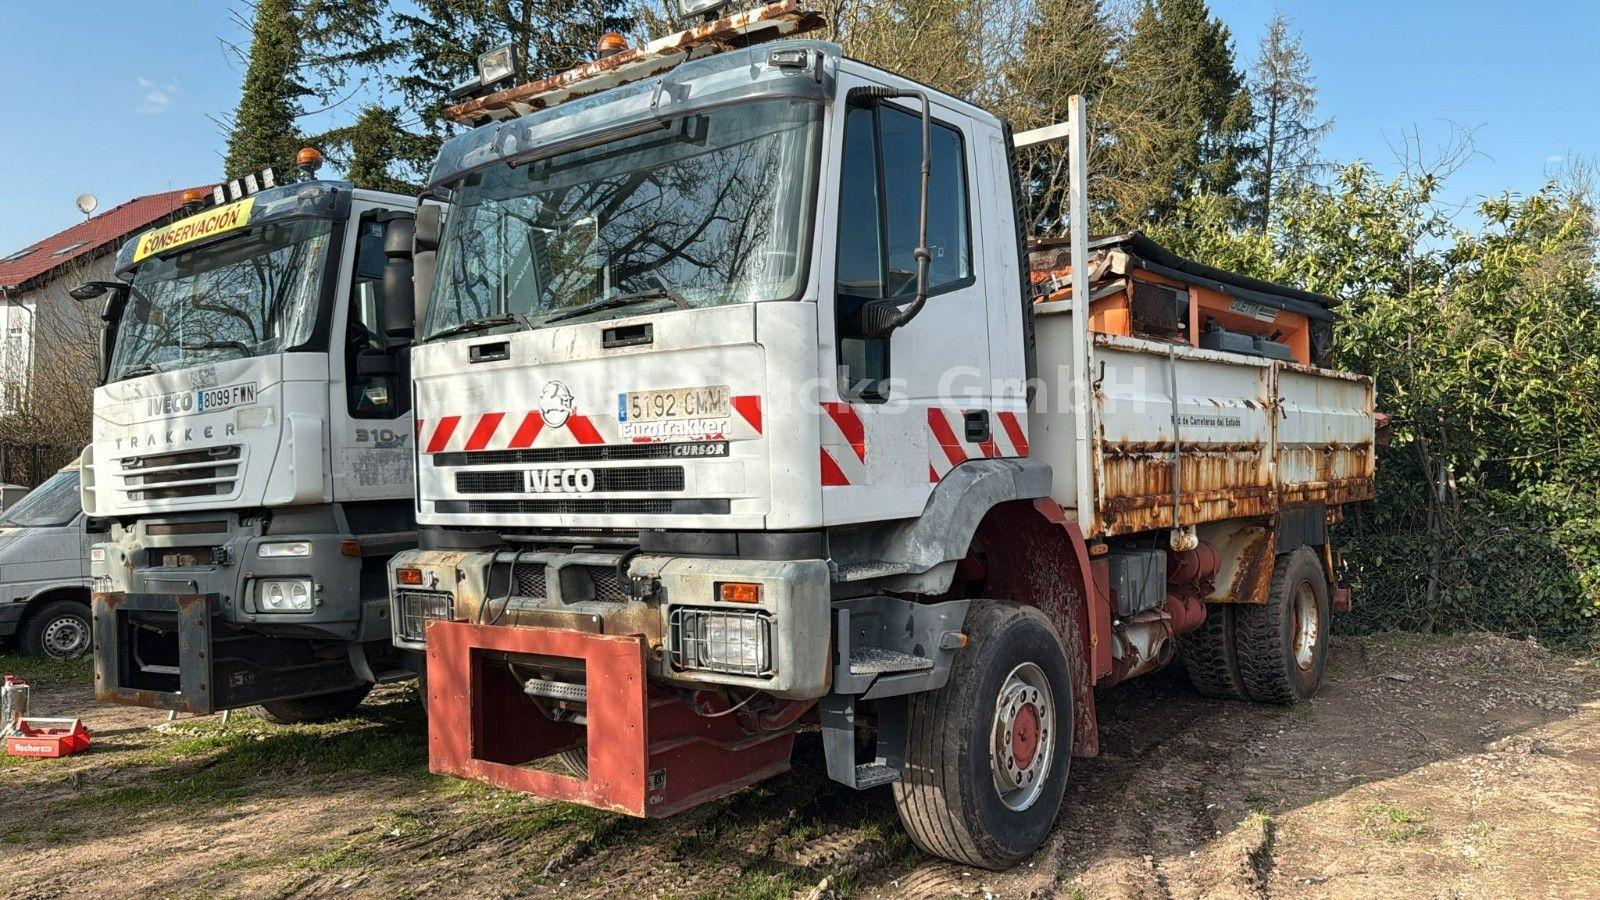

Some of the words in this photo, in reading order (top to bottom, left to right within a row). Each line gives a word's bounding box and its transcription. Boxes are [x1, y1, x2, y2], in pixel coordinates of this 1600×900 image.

[143, 207, 241, 254] CONSERVACIÓN
[148, 391, 193, 416] IVECO
[204, 388, 230, 408] 8099
[233, 384, 255, 404] FWN
[632, 394, 676, 418] 5192
[116, 423, 235, 450] TRAKKER
[355, 428, 394, 442] 310
[622, 419, 728, 437] EuroTrakker
[673, 443, 725, 455] CURSOR
[523, 468, 595, 493] IVECO
[15, 743, 41, 752] fischer
